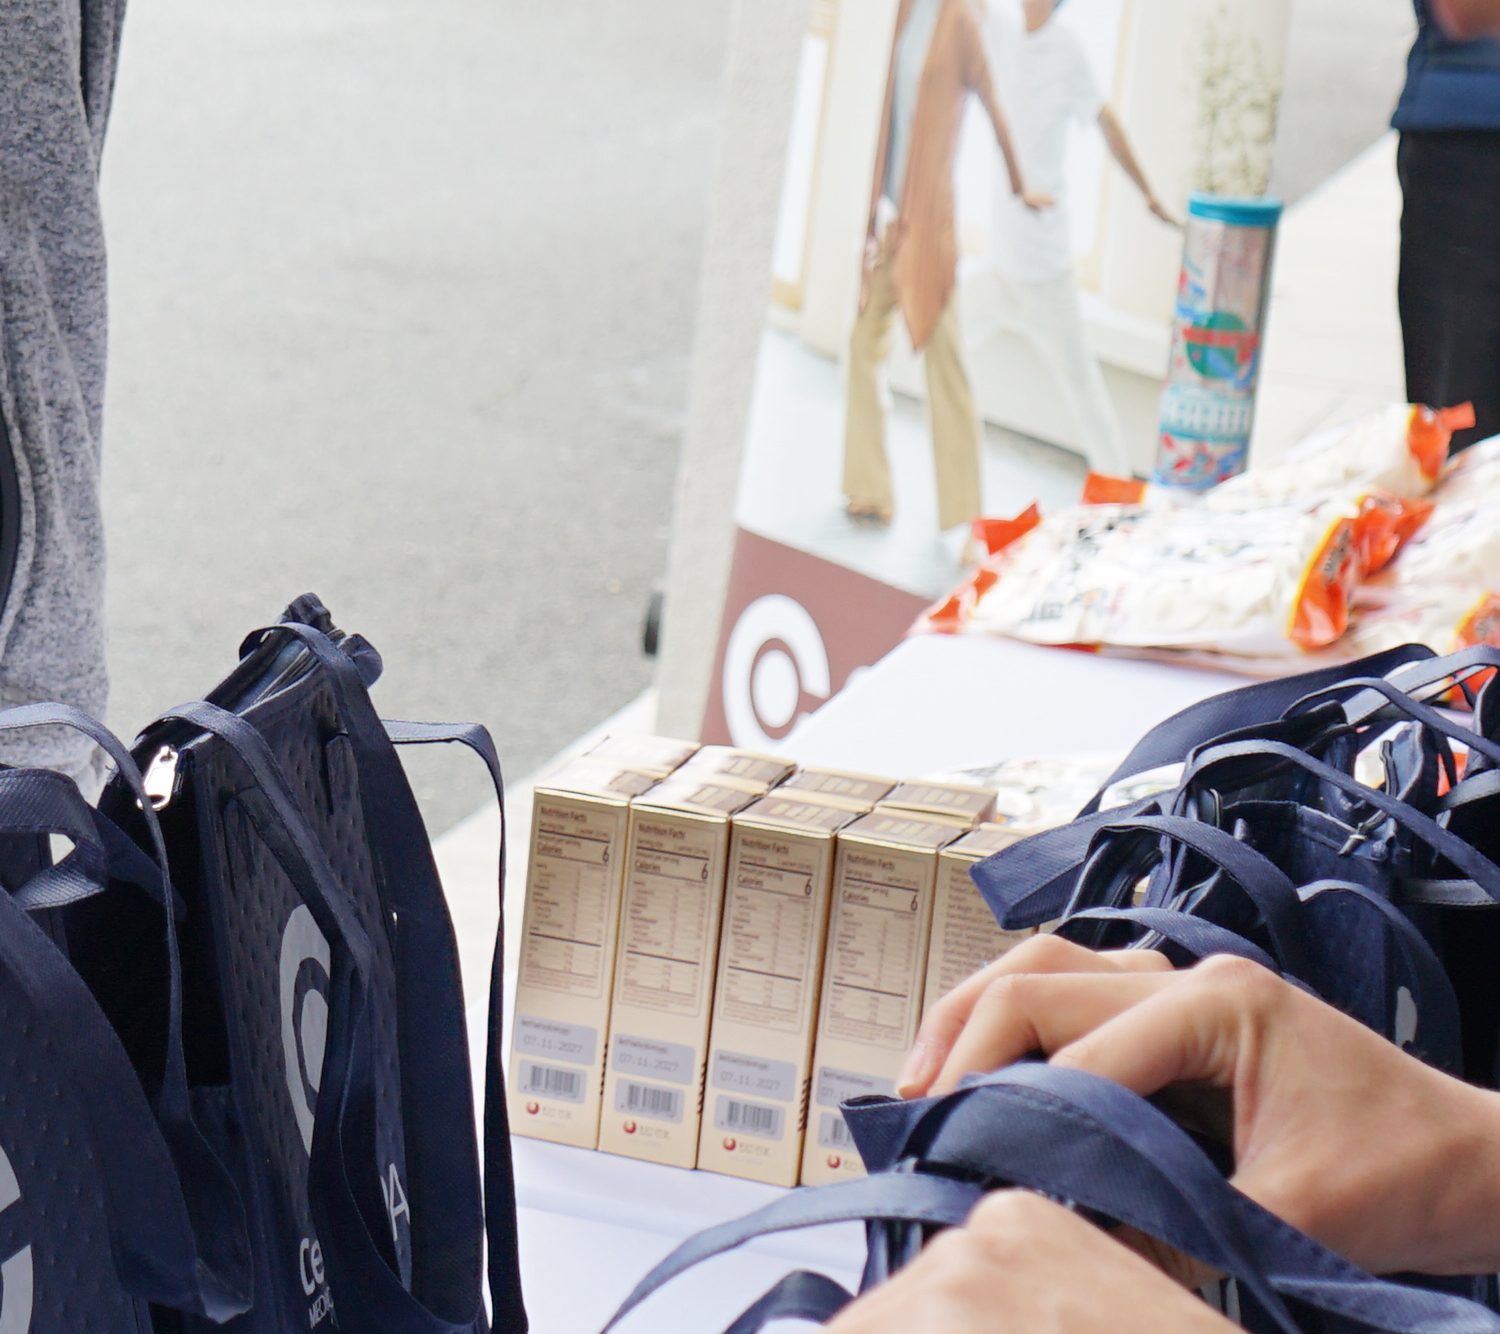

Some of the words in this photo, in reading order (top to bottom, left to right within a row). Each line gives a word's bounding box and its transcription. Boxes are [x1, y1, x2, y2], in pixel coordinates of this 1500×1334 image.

[571, 811, 586, 822] Facts
[668, 829, 685, 839] Facts
[602, 845, 610, 861] 6
[772, 843, 789, 854] Facts
[701, 862, 709, 879] 6
[877, 859, 895, 871] Facts
[804, 877, 812, 893] 6
[910, 893, 918, 910] 6
